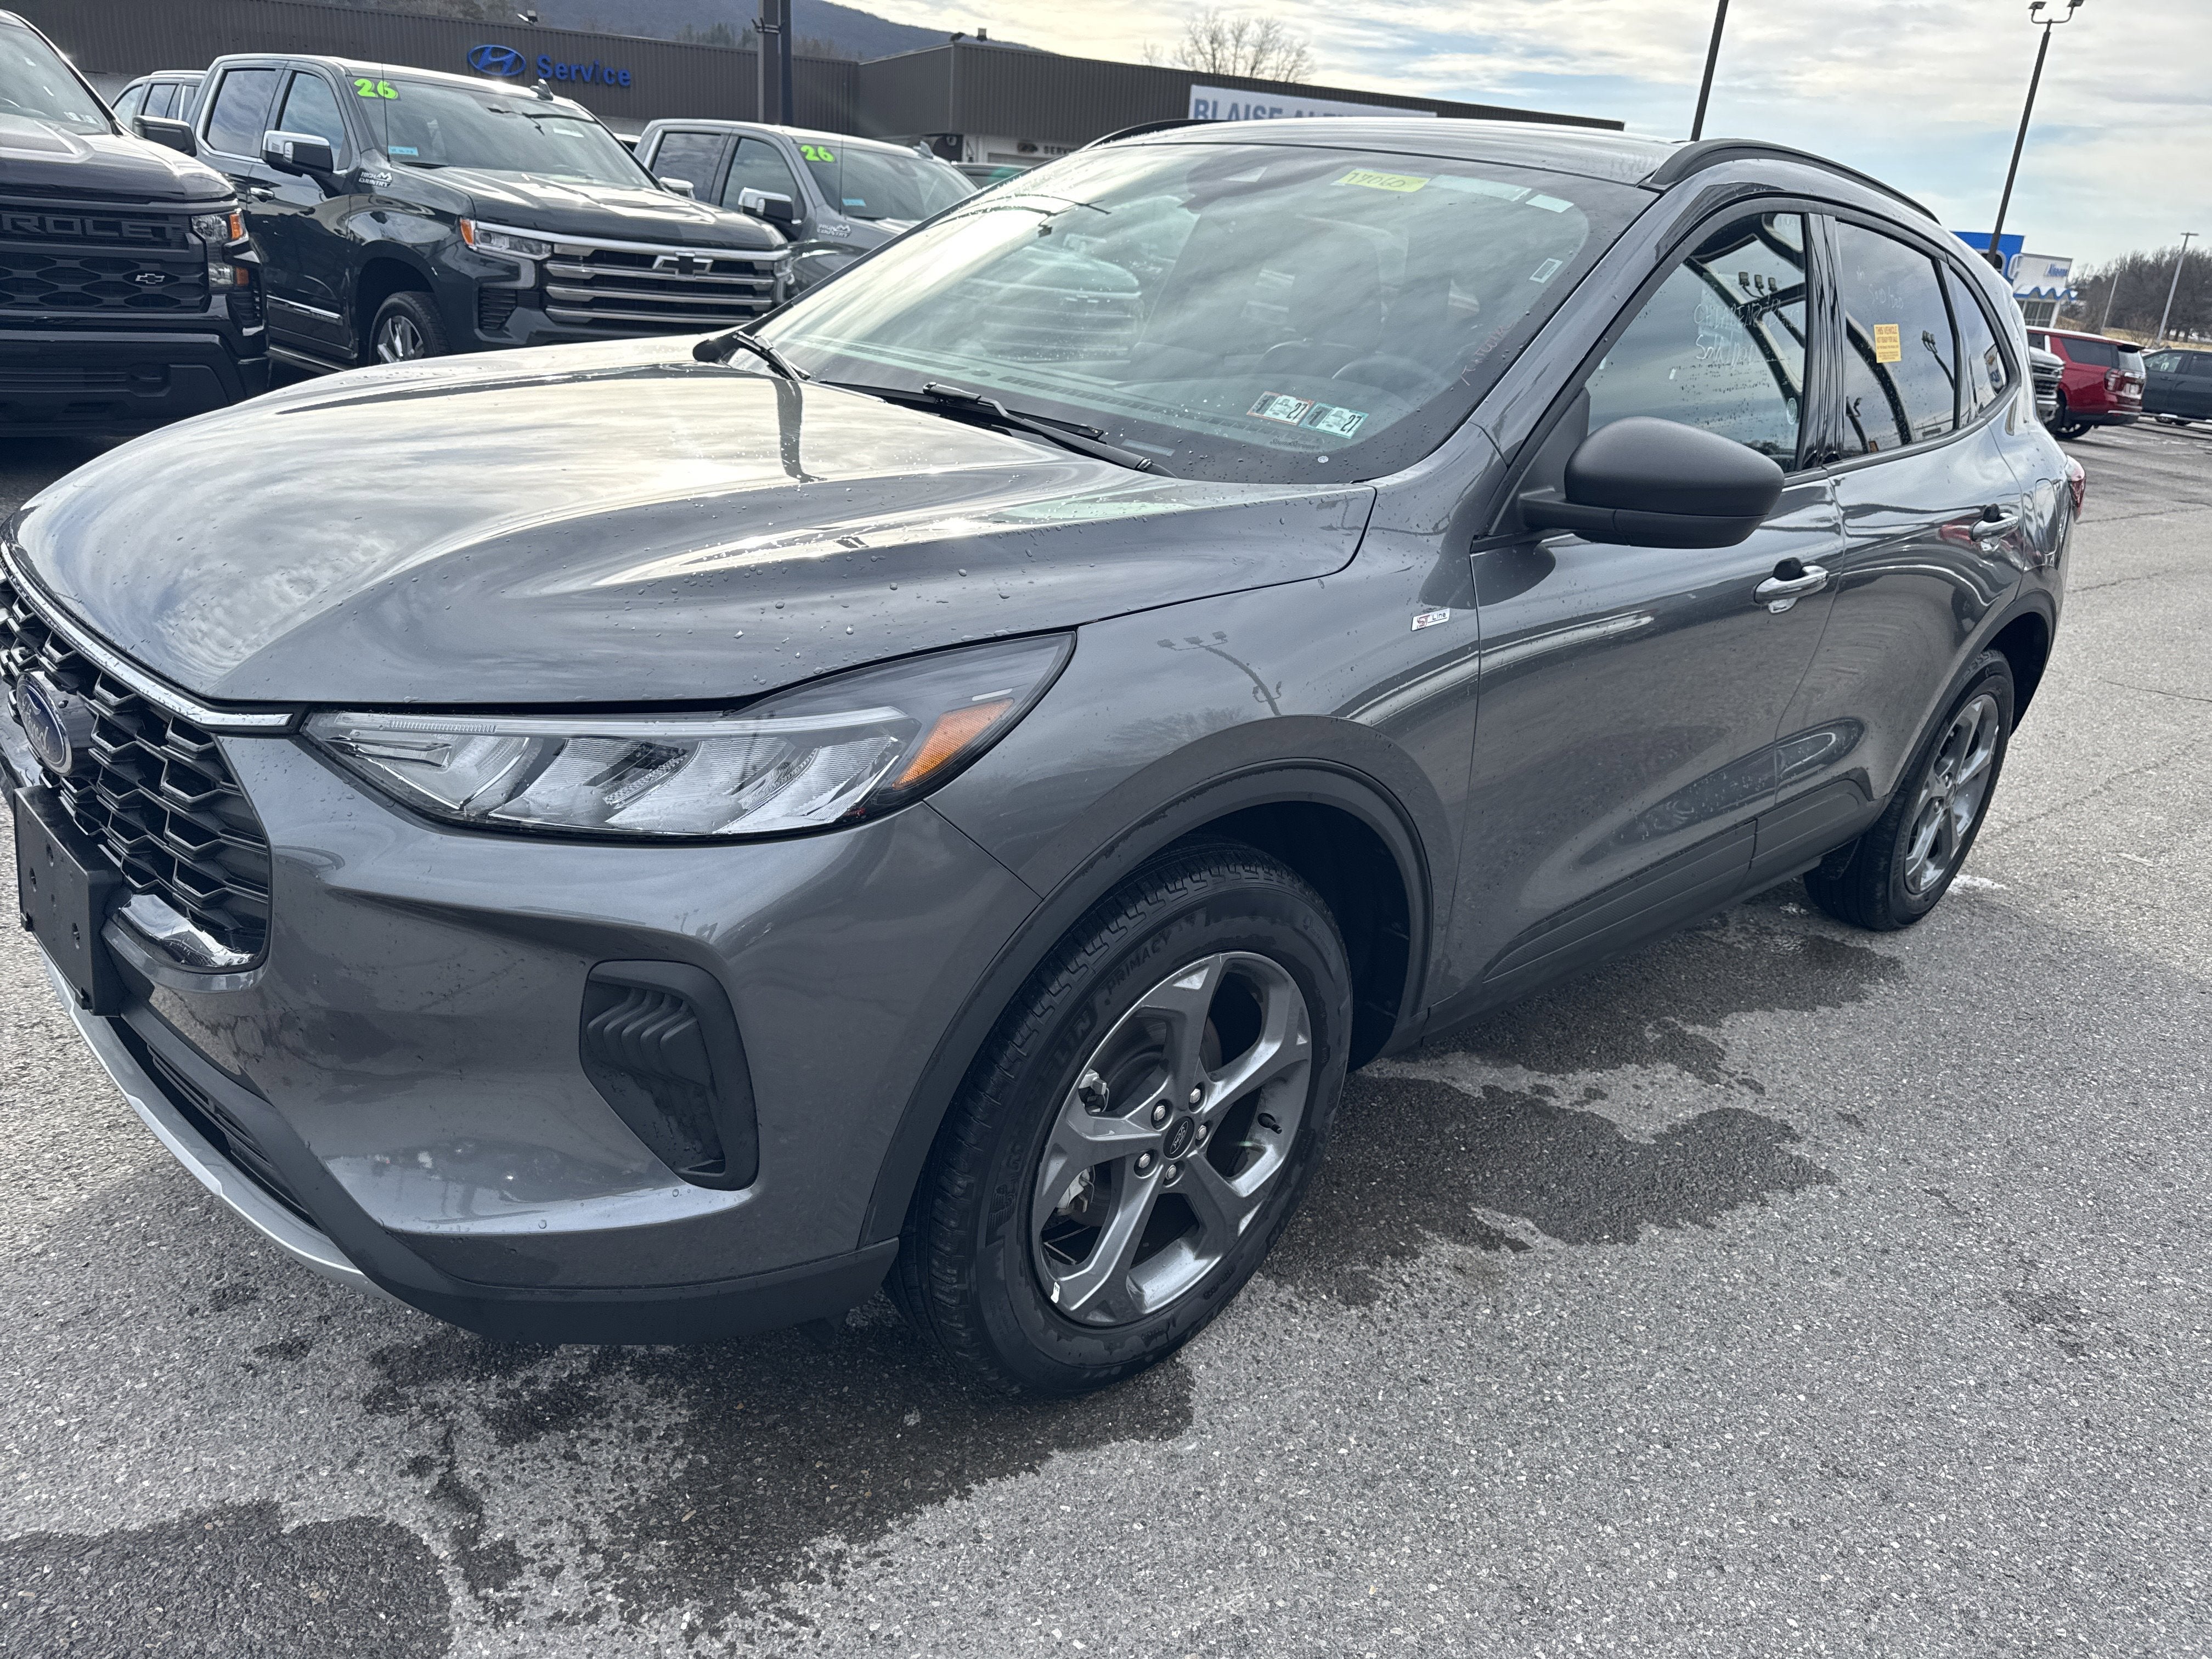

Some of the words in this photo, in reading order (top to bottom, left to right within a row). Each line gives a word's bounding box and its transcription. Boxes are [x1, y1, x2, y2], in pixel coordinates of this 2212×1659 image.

[537, 53, 630, 86] Service
[354, 78, 399, 99] 26
[800, 145, 835, 162] 26
[1286, 402, 1308, 420] 27
[1340, 415, 1363, 433] 27
[1432, 612, 1446, 620] Line
[22, 693, 49, 755] Ford
[1105, 929, 1172, 996] PRIMACY
[1173, 1126, 1186, 1148] Ford
